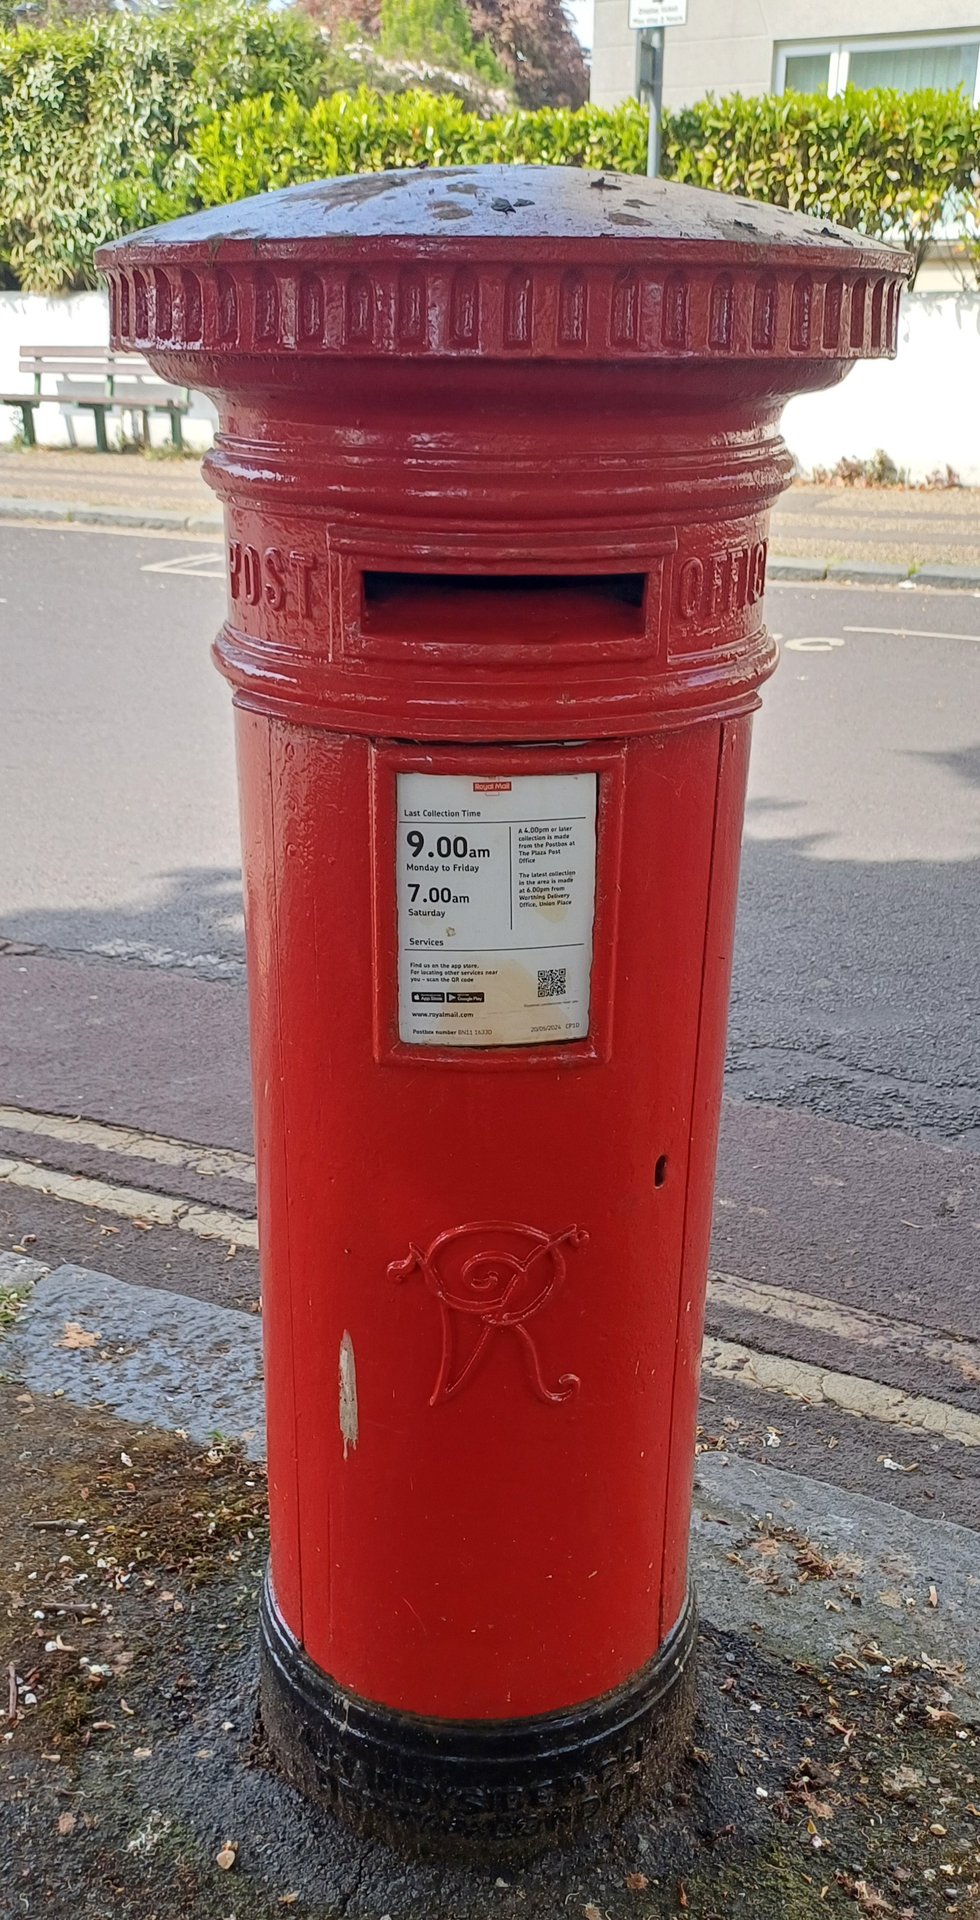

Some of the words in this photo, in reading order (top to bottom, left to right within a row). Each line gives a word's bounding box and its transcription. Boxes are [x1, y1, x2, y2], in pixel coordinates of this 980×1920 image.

[229, 541, 318, 620] POST
[680, 538, 768, 617] OFFIC
[474, 783, 494, 791] Royal
[423, 809, 460, 817] Collection
[406, 830, 490, 858] 9.00am
[407, 864, 439, 873] Monday
[453, 864, 479, 873] Friday
[408, 884, 470, 904] 7.00am
[408, 909, 446, 918] Saturday
[409, 938, 444, 946] Services
